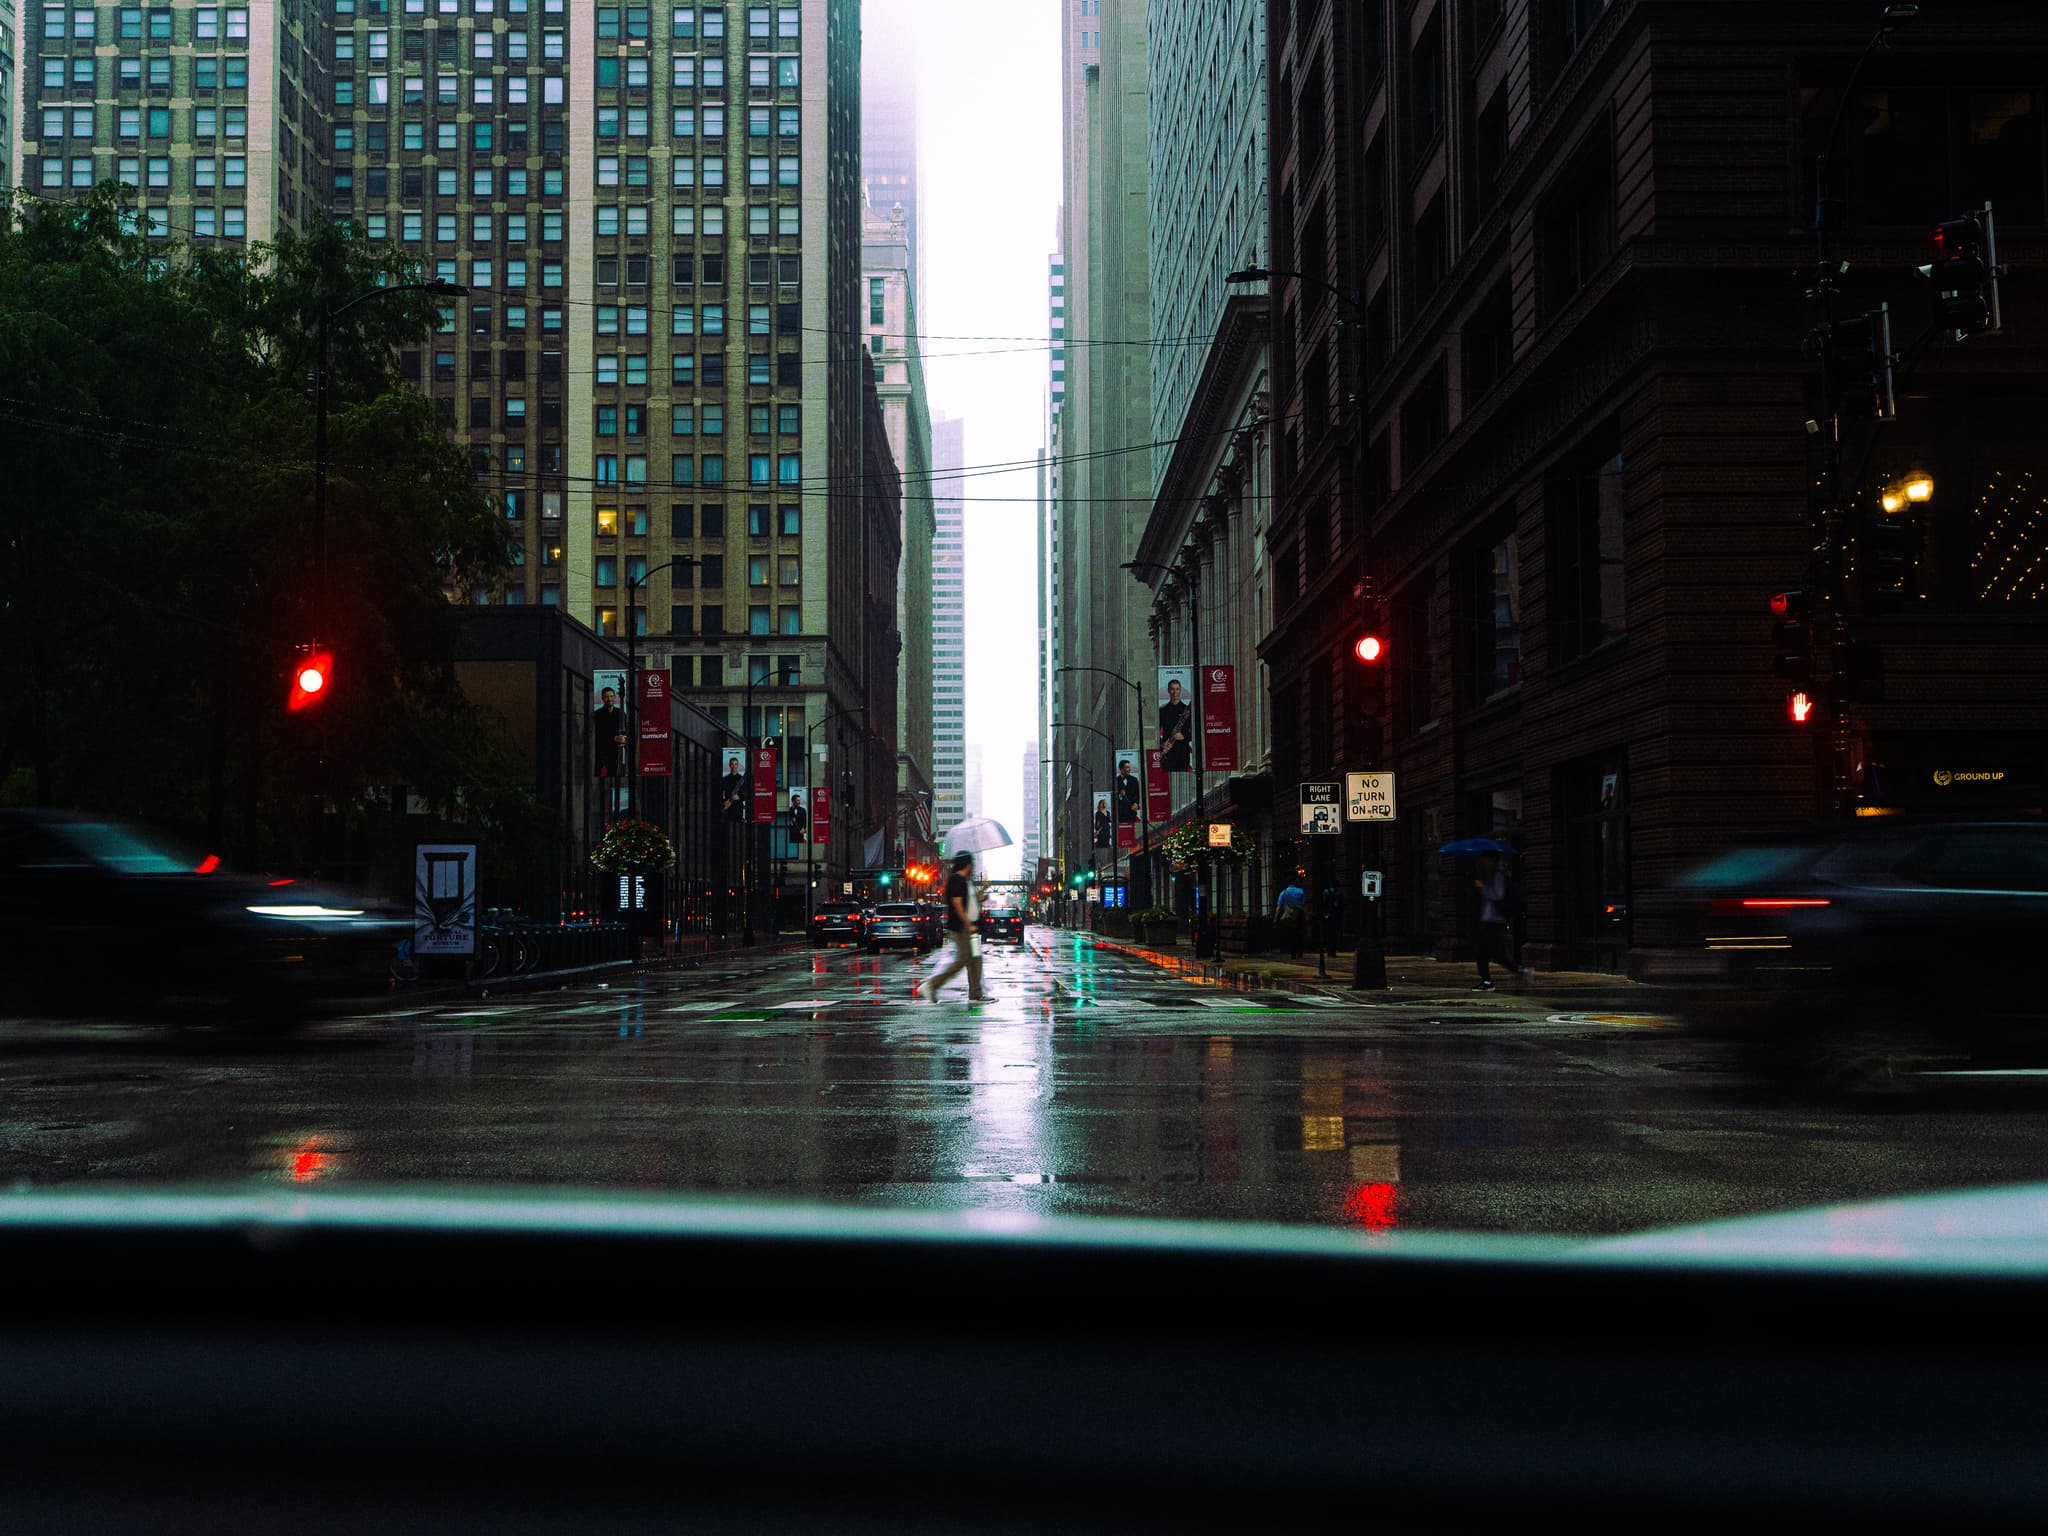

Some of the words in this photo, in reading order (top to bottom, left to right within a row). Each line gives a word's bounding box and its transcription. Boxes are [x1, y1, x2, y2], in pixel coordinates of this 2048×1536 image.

[641, 732, 667, 740] surround
[1953, 772, 1991, 781] GROUND
[1991, 771, 2004, 780] UP
[1362, 778, 1379, 788] NO
[1309, 785, 1331, 793] RIGHT
[1310, 793, 1331, 802] LANE
[1357, 791, 1384, 801] TURN
[1352, 805, 1366, 815] ON
[1372, 805, 1391, 815] RED
